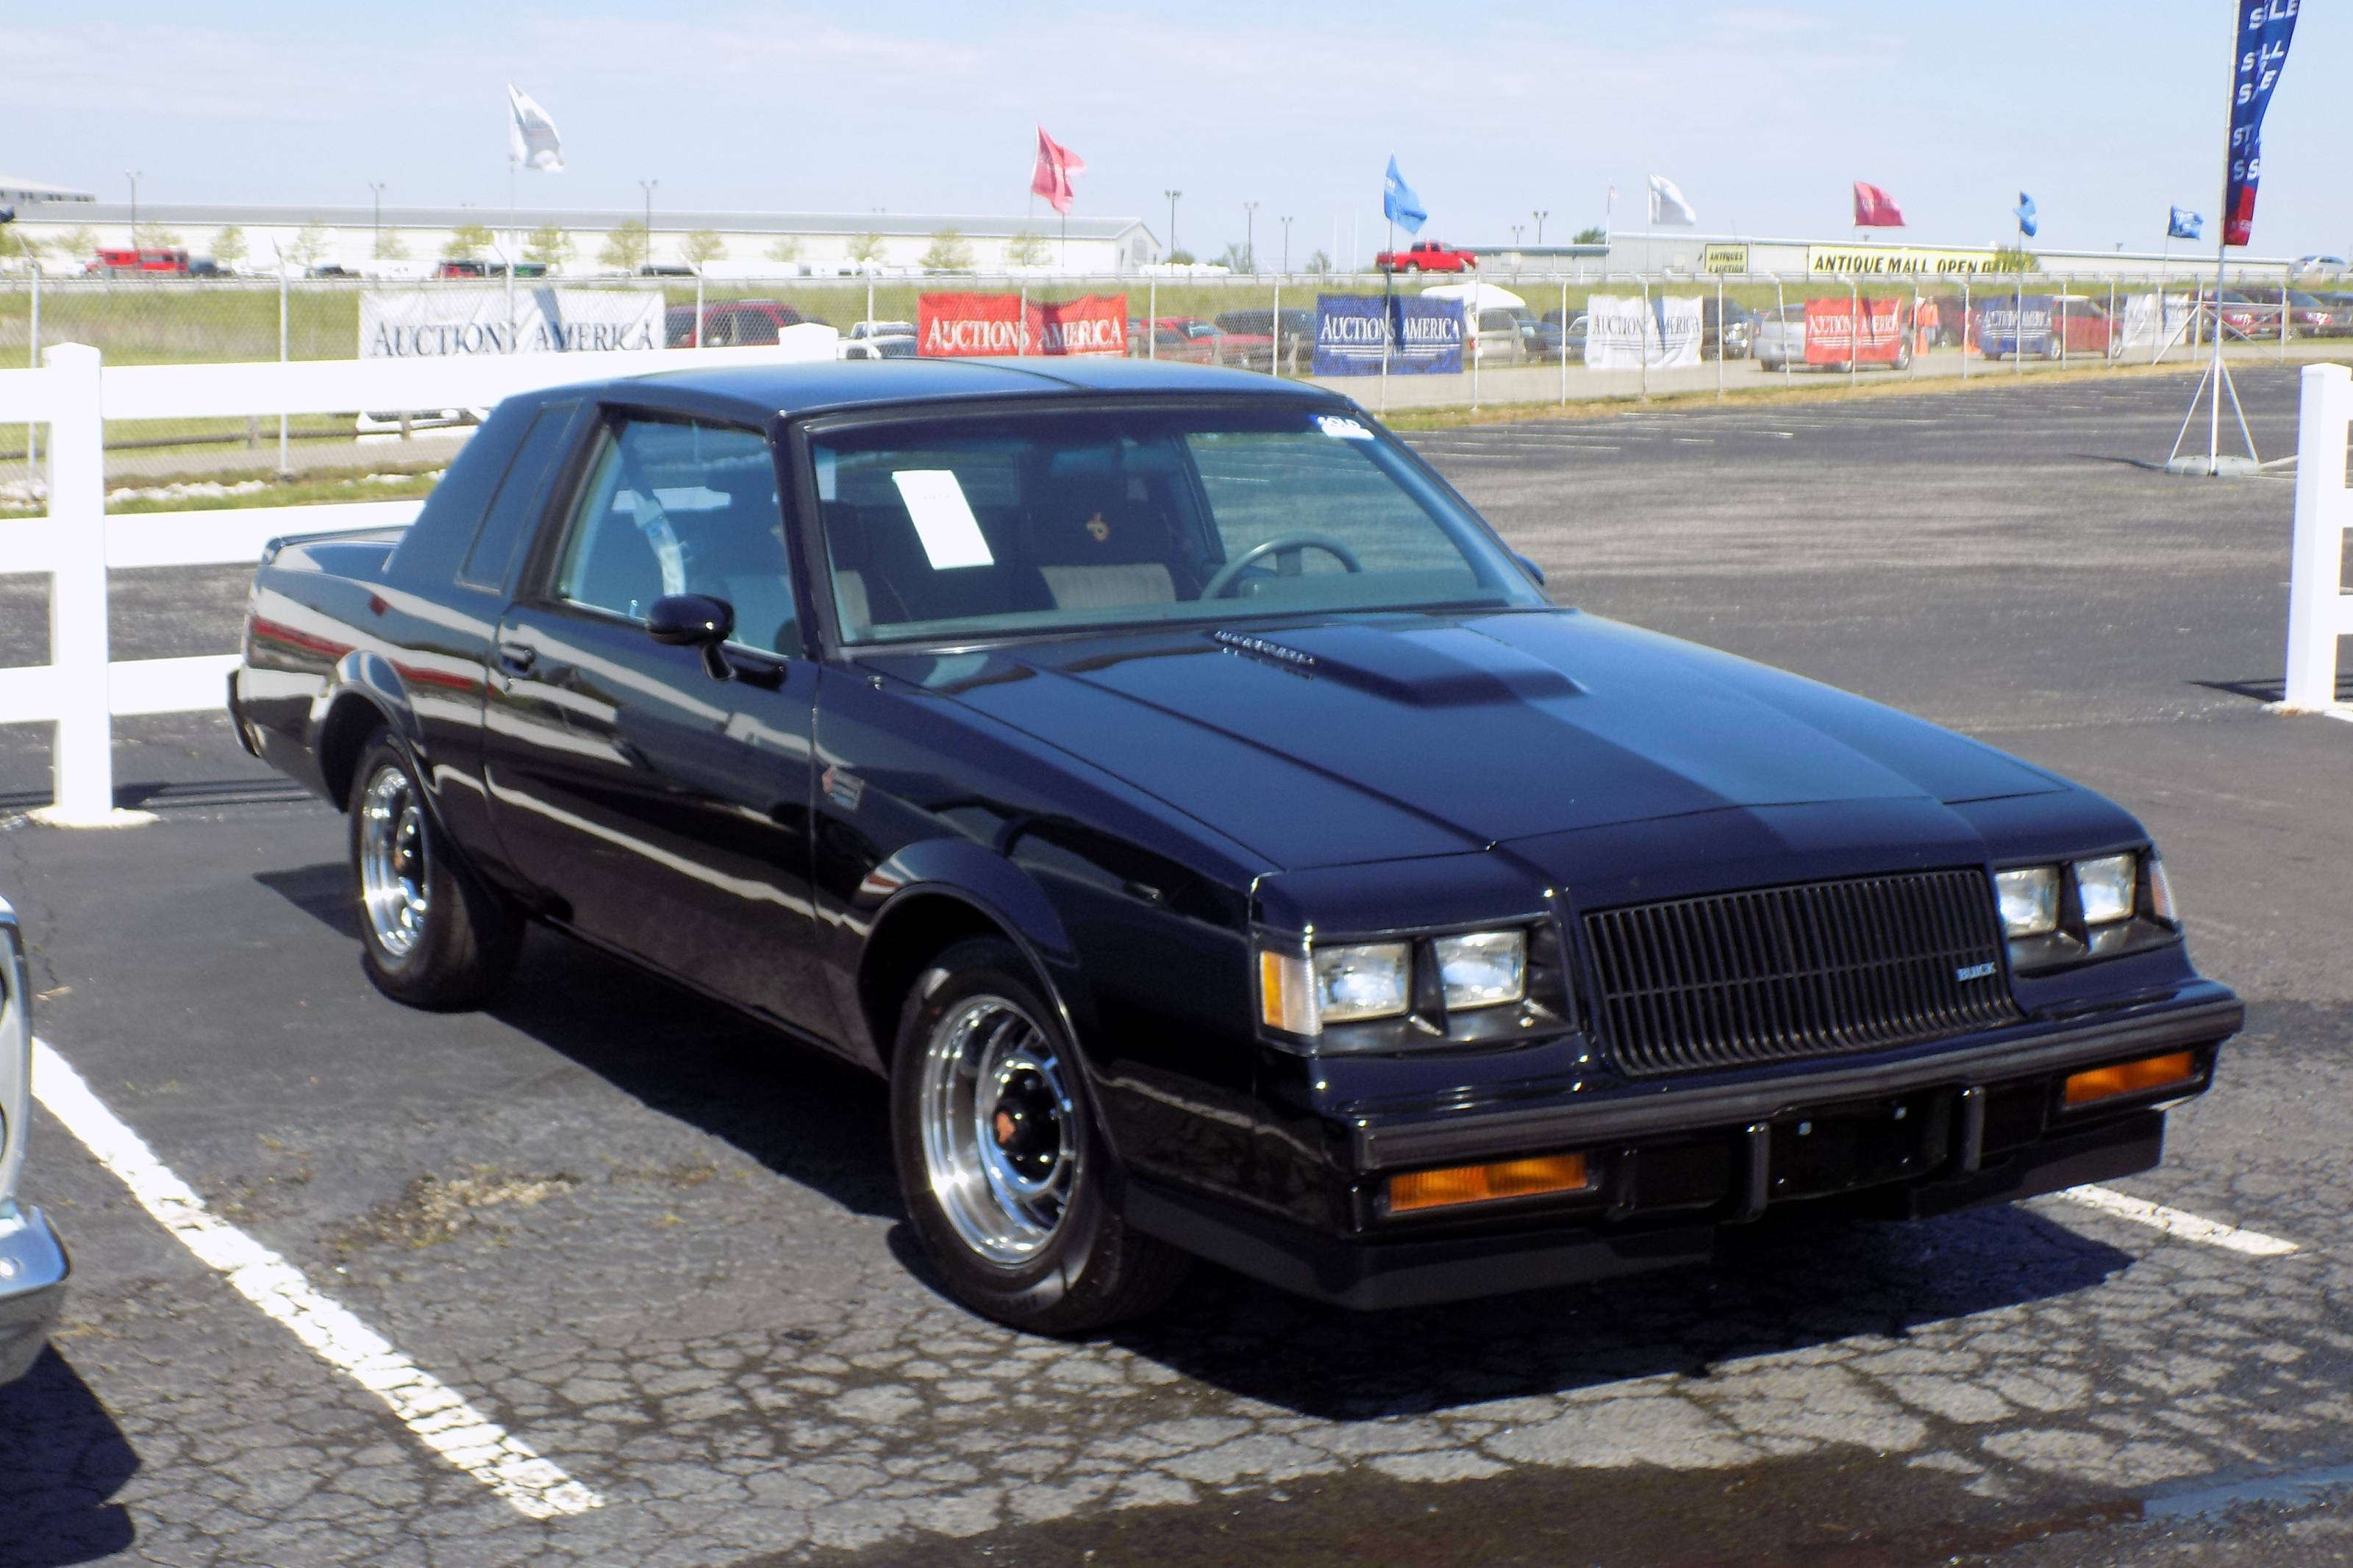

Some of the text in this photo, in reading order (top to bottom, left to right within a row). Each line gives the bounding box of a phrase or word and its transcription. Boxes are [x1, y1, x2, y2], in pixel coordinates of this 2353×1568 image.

[2248, 0, 2297, 30] SLE
[1709, 251, 1744, 261] ANTIQUES
[1814, 254, 1884, 273] ANTIQUE
[1888, 257, 1929, 273] MALL
[1936, 258, 1977, 273] OPEN
[1038, 315, 1123, 350] AMERICA
[1402, 316, 1460, 339] AMERICA
[1593, 314, 1644, 335] AUCTION
[1809, 314, 1855, 334] AUCTION
[535, 319, 654, 353] AMERICA
